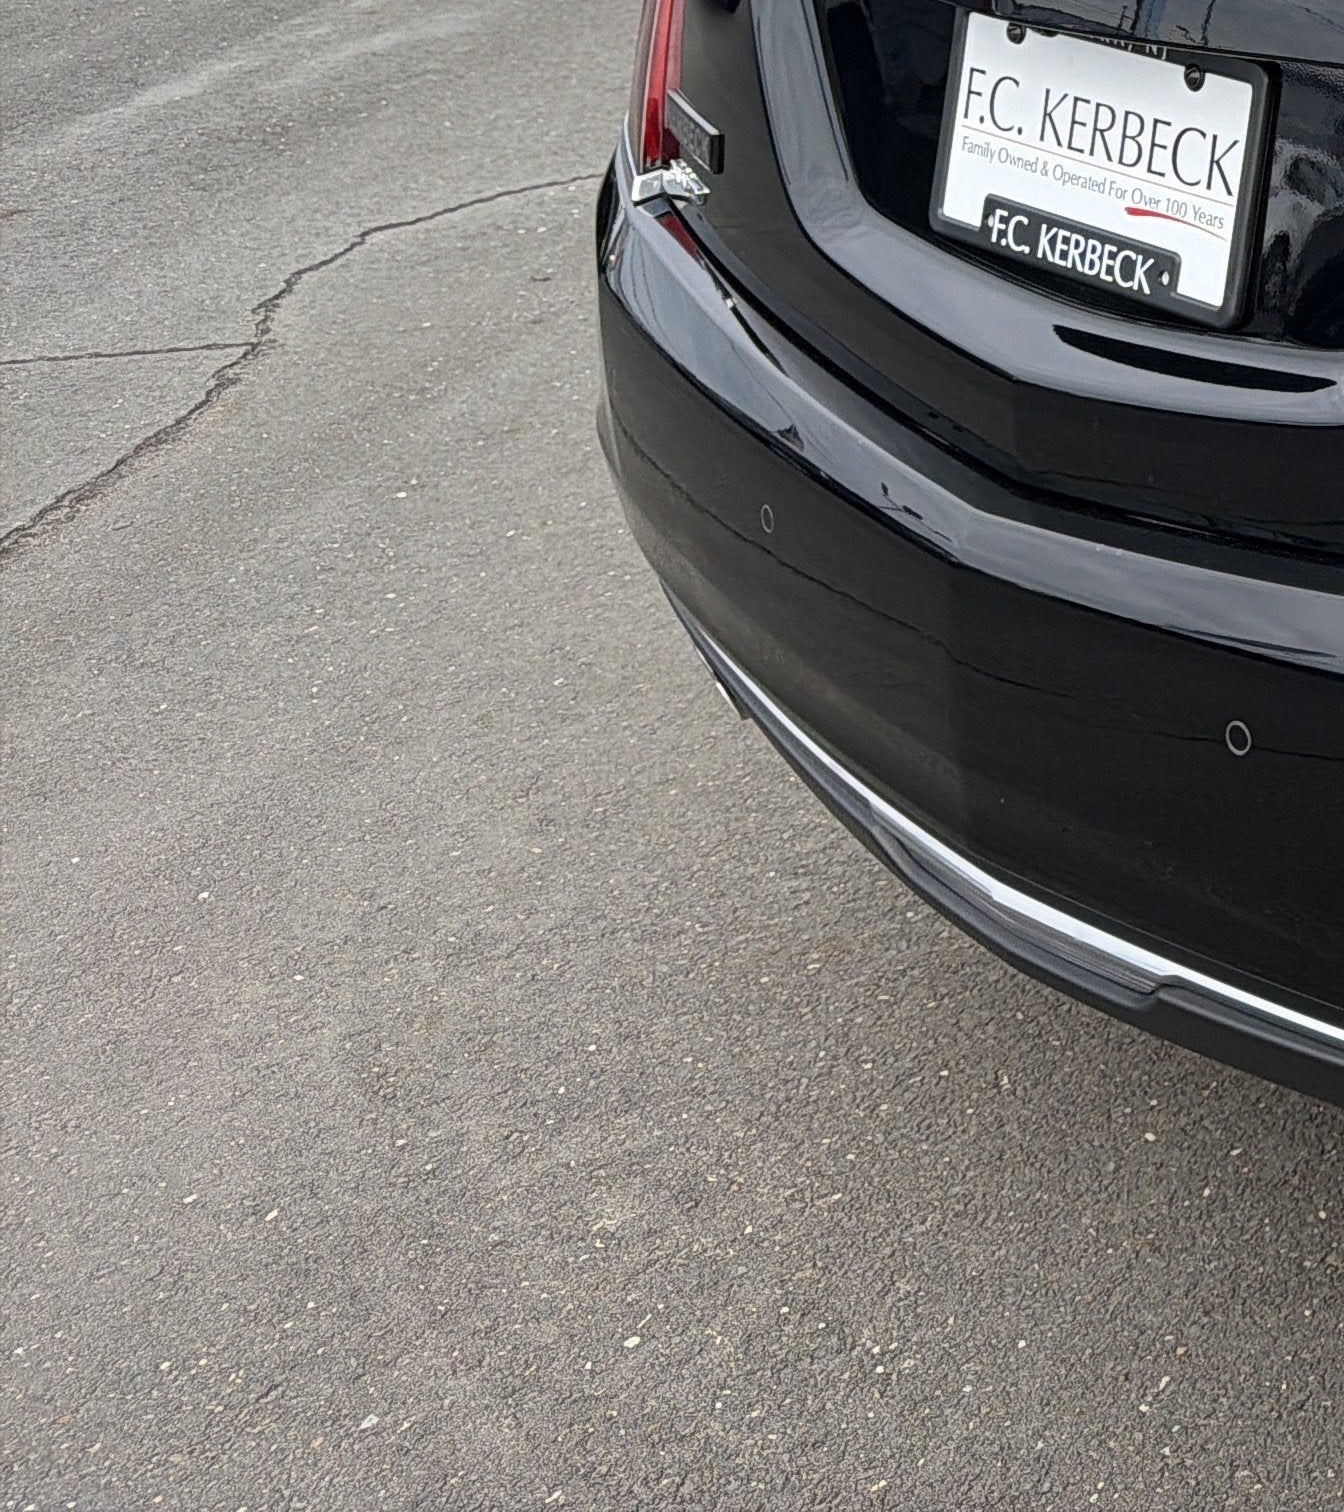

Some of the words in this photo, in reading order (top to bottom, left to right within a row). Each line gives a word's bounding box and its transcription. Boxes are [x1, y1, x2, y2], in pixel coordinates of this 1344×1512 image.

[963, 66, 1023, 136] F.C.
[1038, 87, 1241, 198] KERBECK
[961, 136, 997, 164] Family
[998, 147, 1038, 173] Owned
[1040, 161, 1050, 177] &
[1052, 163, 1106, 195] Operated
[1108, 180, 1127, 201] For
[1131, 188, 1161, 211] Over
[1165, 198, 1188, 218] 100
[1191, 204, 1225, 230] Years
[990, 208, 1030, 256] F.C.
[1036, 222, 1155, 295] KERBECK
